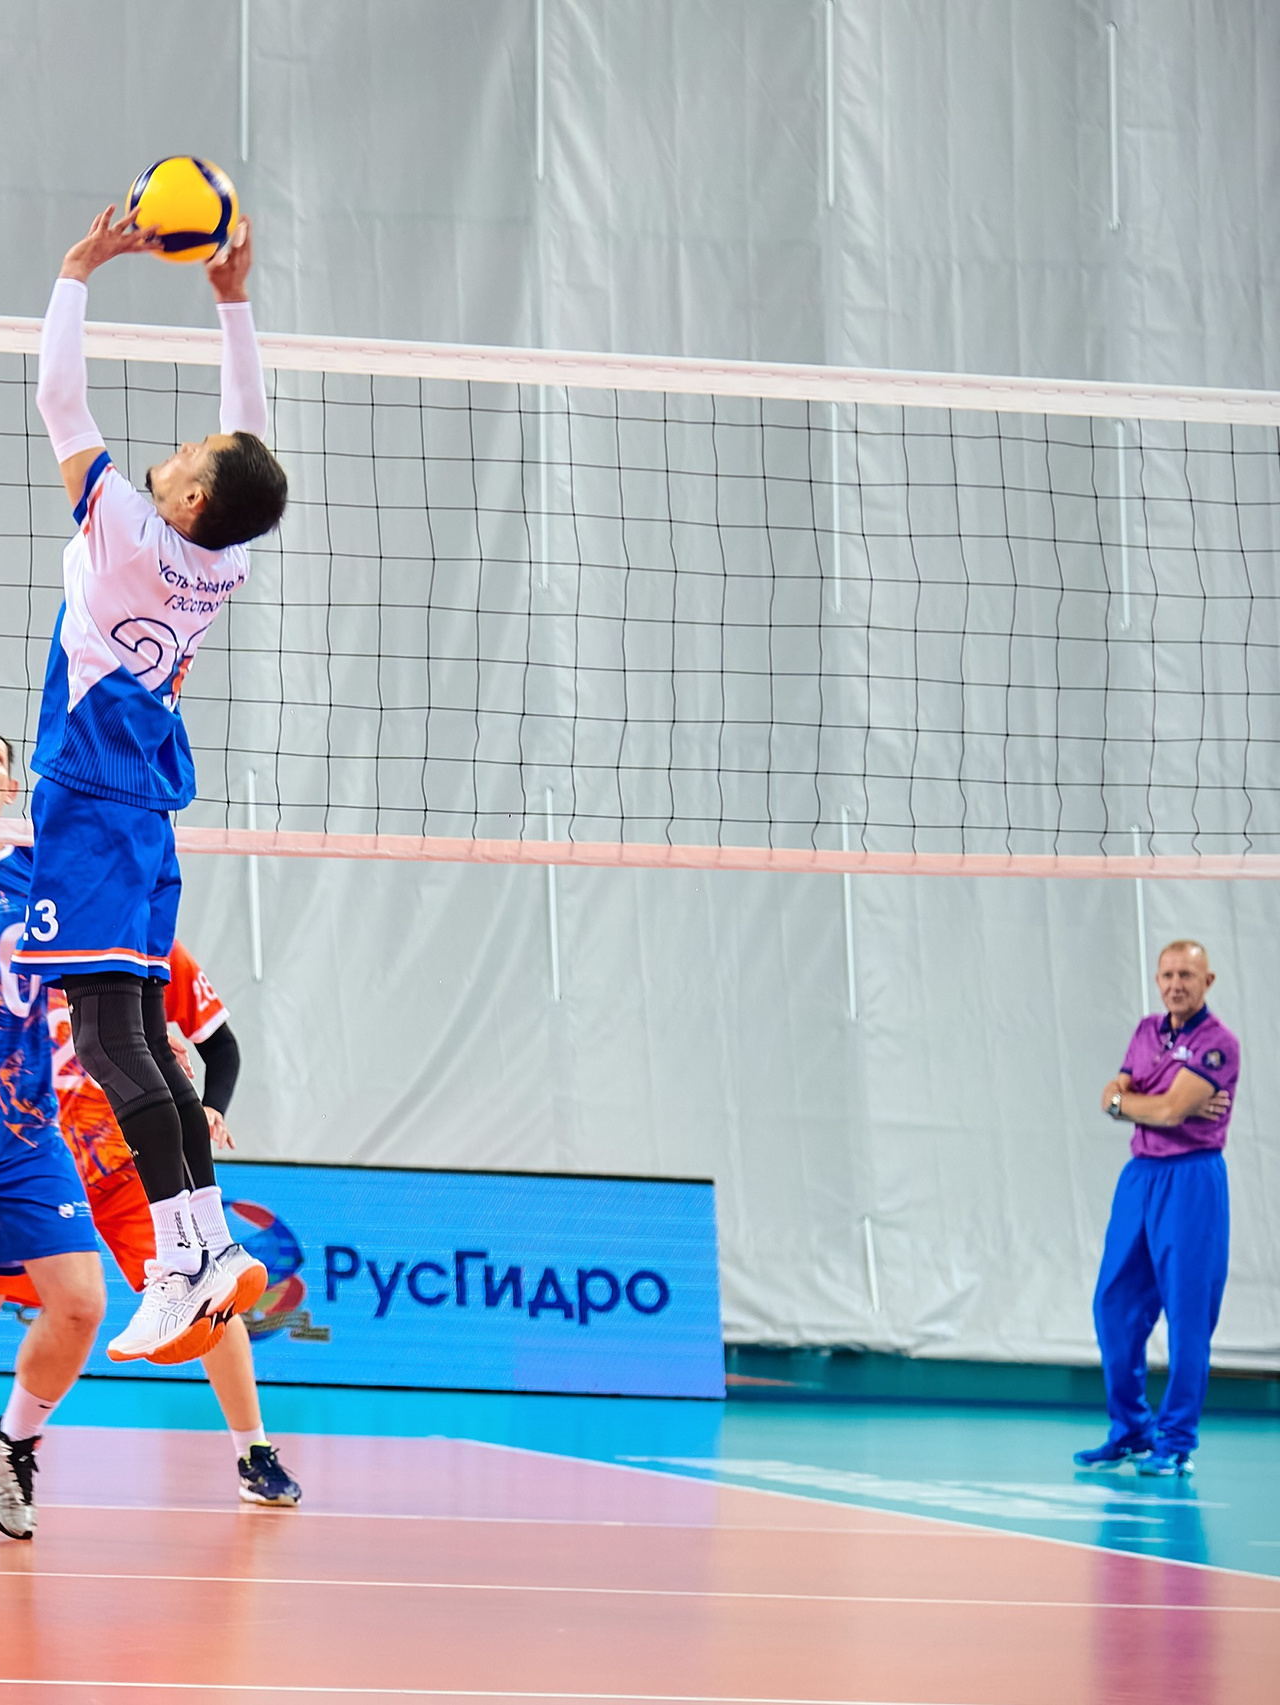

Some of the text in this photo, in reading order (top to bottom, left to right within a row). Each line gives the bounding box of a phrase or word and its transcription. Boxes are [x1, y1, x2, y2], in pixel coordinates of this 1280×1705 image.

[165, 593, 225, 616] ГЭСстро
[23, 898, 60, 942] 3
[192, 970, 219, 1012] 28
[324, 1245, 671, 1325] РусГидро
